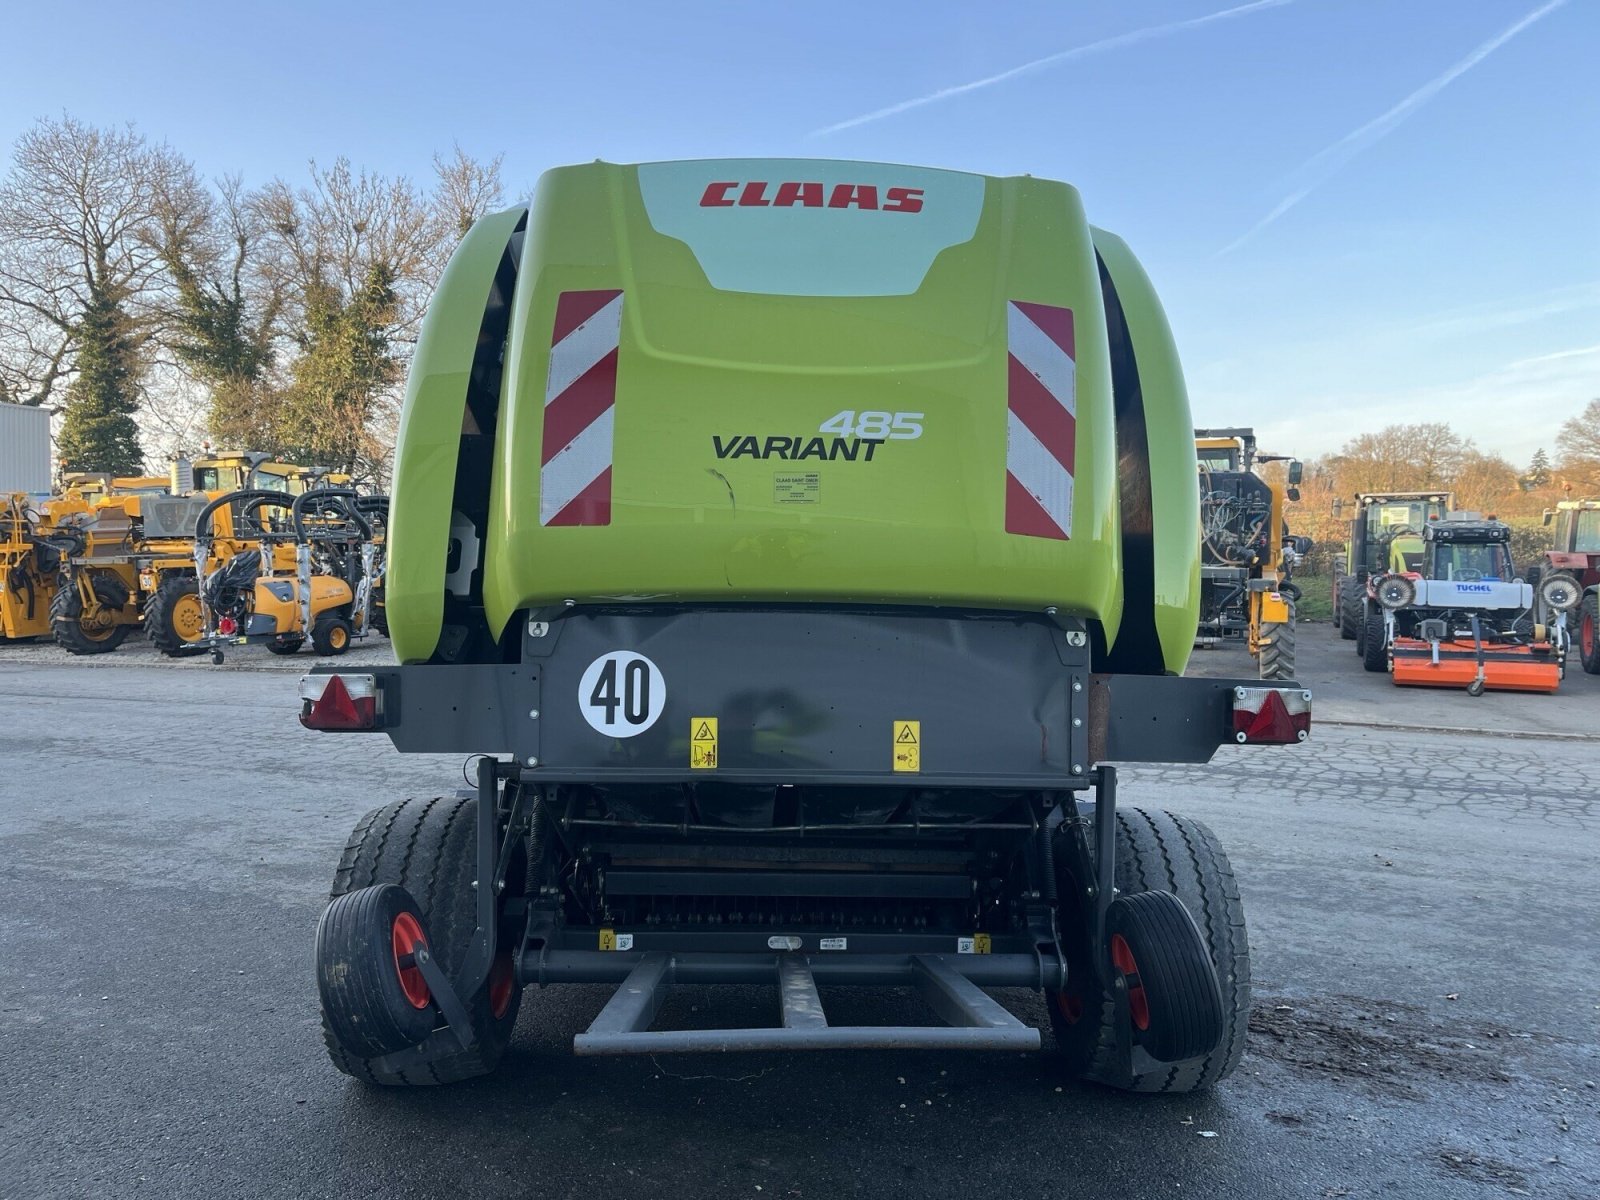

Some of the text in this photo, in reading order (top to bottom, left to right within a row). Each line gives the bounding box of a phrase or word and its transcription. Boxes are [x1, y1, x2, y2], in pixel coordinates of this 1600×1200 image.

[699, 181, 924, 213] CLAAS
[819, 409, 925, 440] 485
[712, 435, 885, 462] VARIANT
[1456, 584, 1492, 592] TUCHEL
[590, 659, 650, 725] 40
